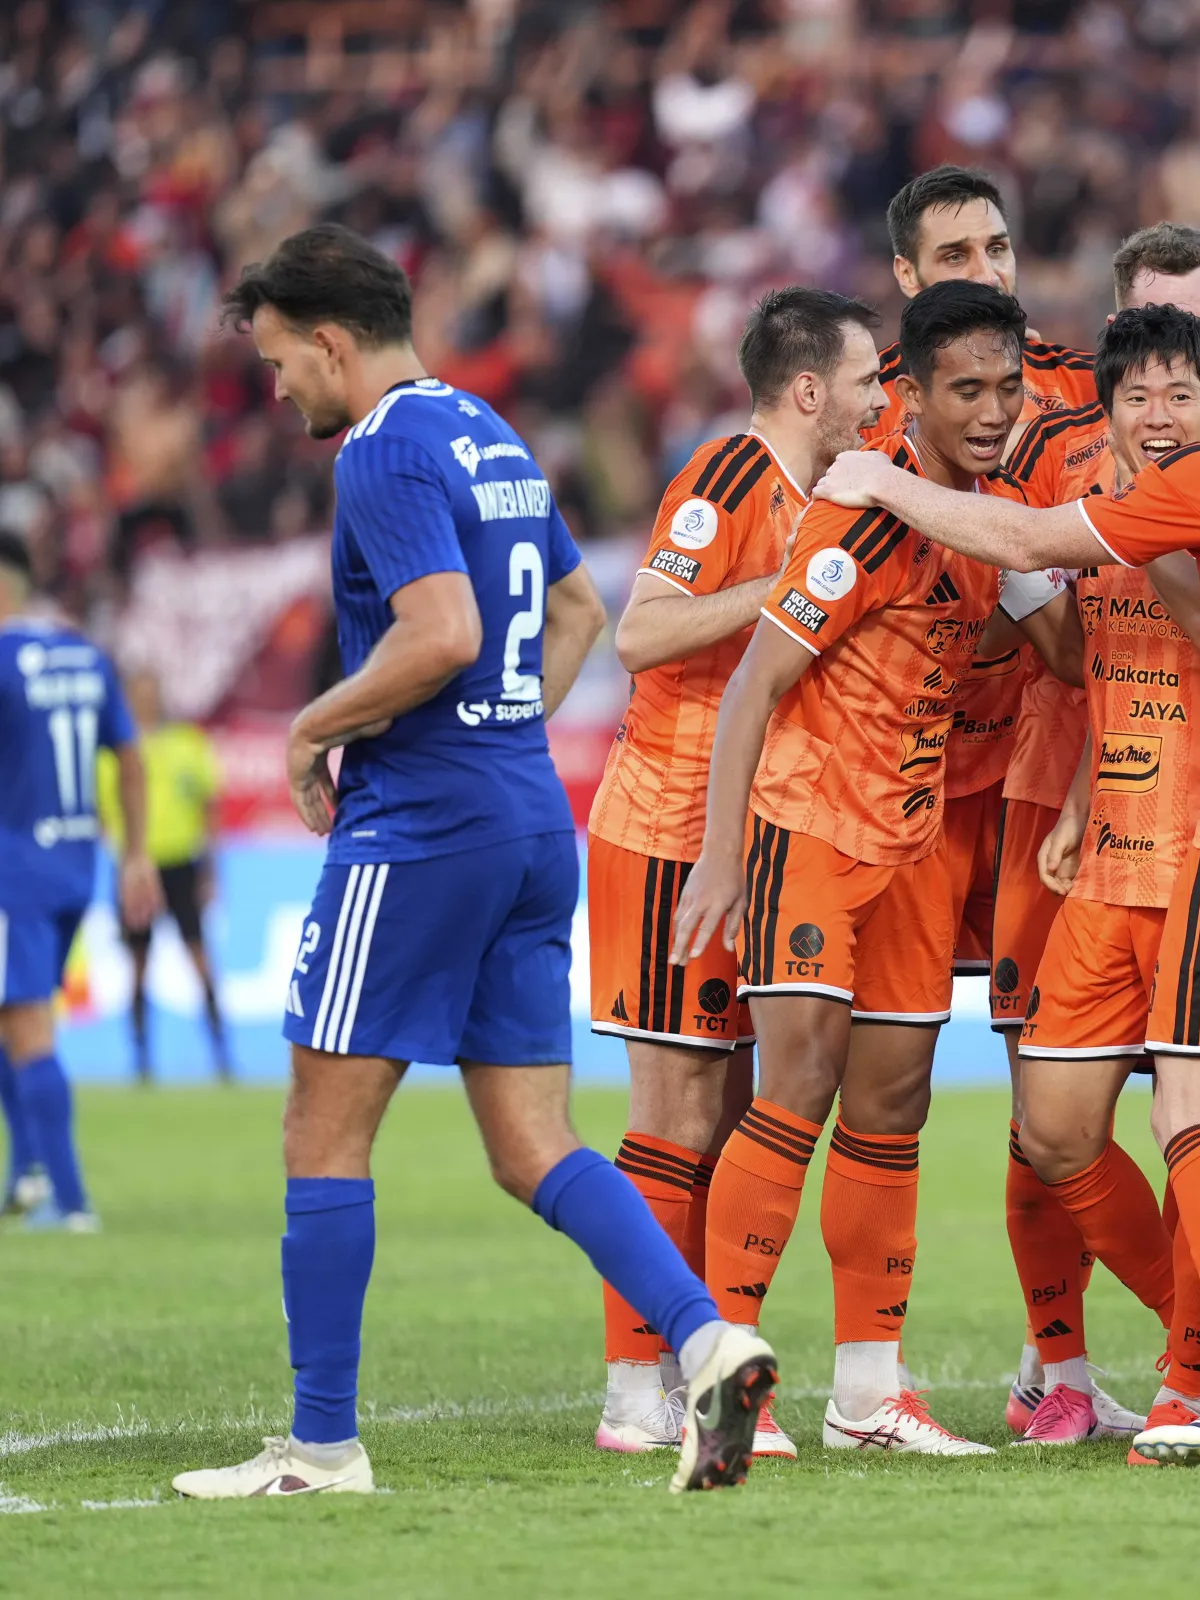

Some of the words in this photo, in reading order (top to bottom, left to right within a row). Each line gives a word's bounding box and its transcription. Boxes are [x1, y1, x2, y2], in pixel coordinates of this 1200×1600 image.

[652, 558, 695, 582] RACISM
[657, 549, 678, 566] KICK
[676, 554, 698, 571] OUT
[781, 599, 820, 632] RACISM
[788, 590, 808, 610] KICK
[805, 603, 825, 621] OUT
[1109, 598, 1171, 621] MAC
[501, 541, 545, 700] 2
[1111, 650, 1133, 661] Bank
[1105, 664, 1180, 688] Jakarta
[1128, 700, 1187, 722] JAYA
[47, 704, 98, 816] 11
[1109, 834, 1155, 852] Bakrie
[296, 920, 321, 975] 2
[785, 960, 824, 978] TCT
[992, 995, 1020, 1011] TCT
[693, 1014, 729, 1033] TCT
[1022, 1022, 1038, 1038] CT
[743, 1233, 786, 1257] PSJ
[886, 1257, 914, 1275] PS
[1032, 1279, 1067, 1304] PSJ
